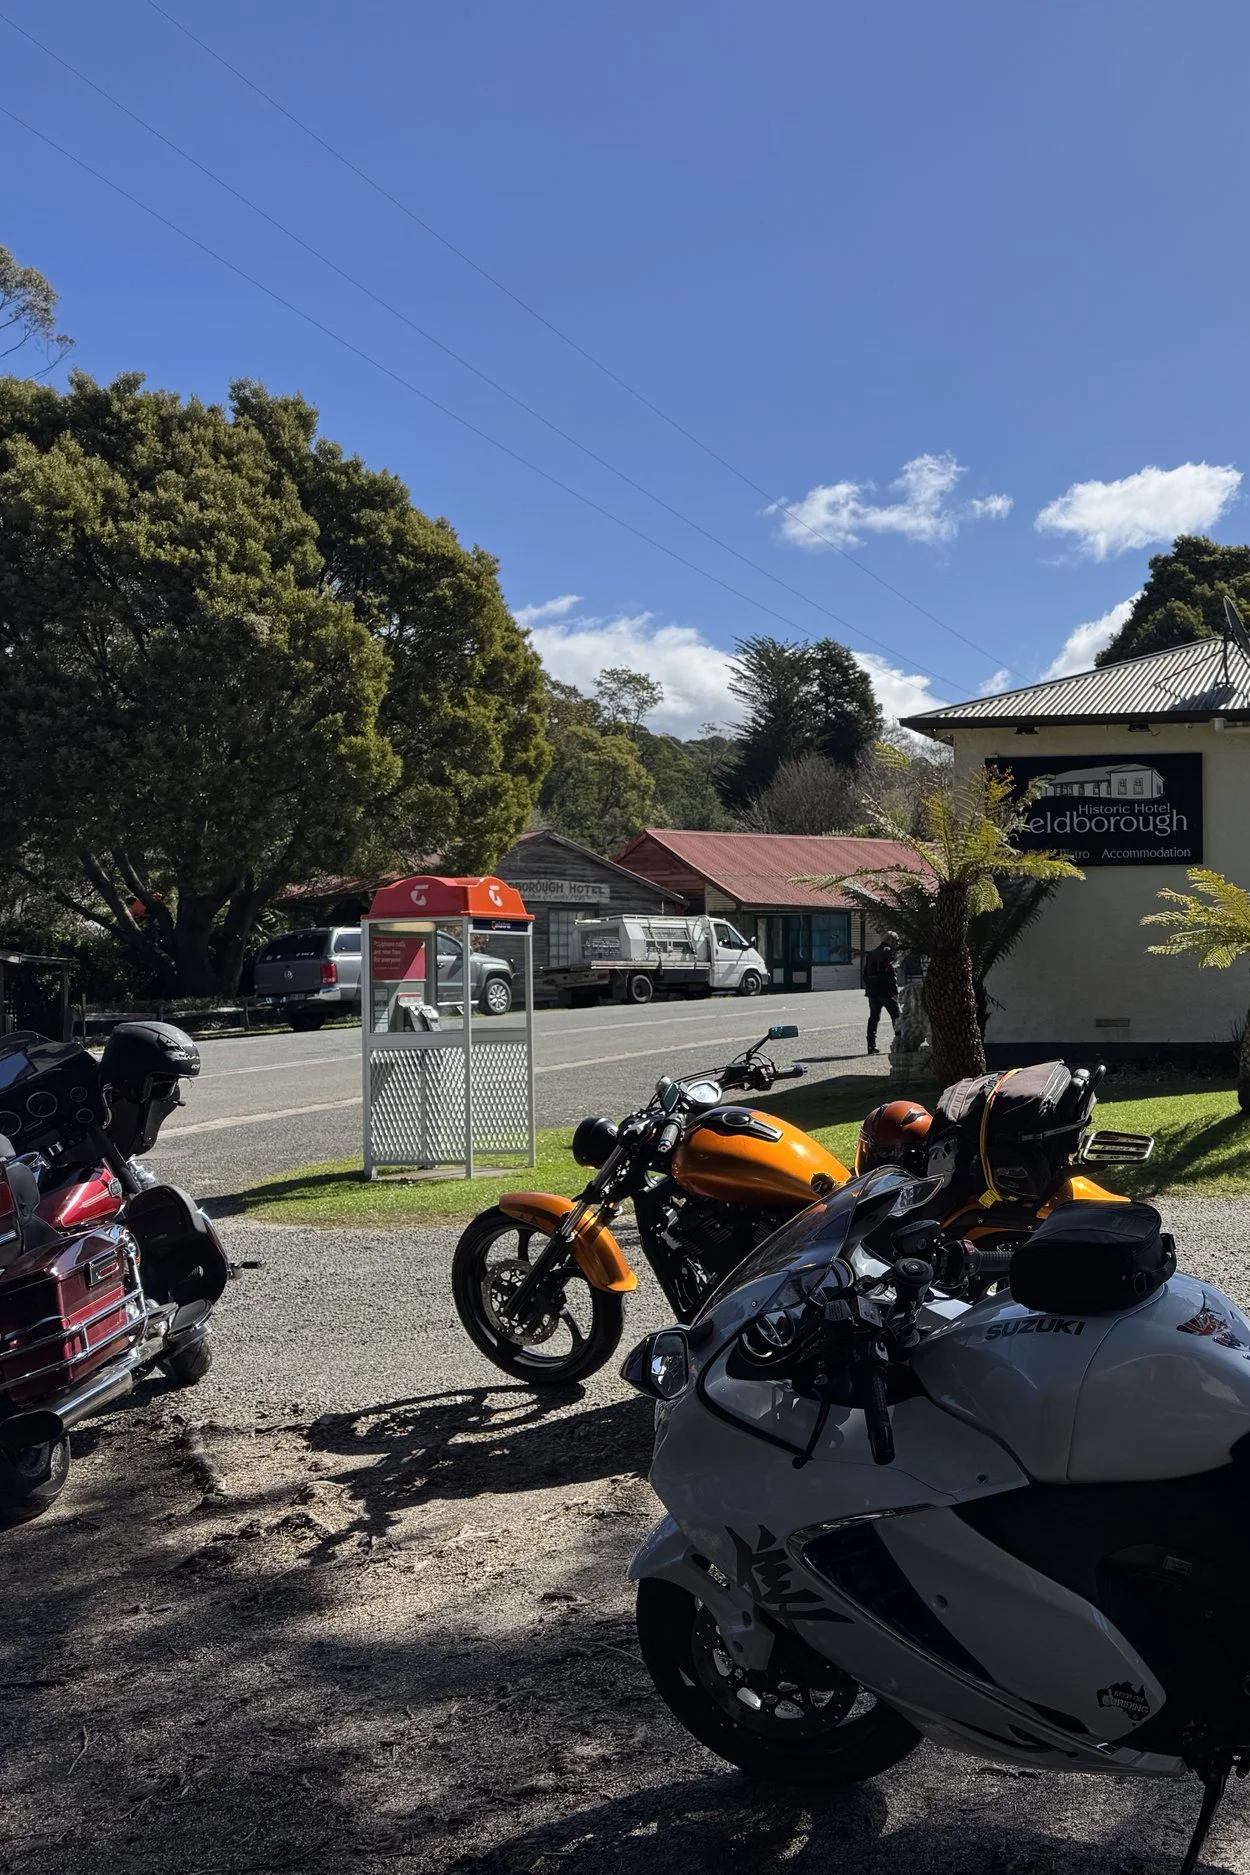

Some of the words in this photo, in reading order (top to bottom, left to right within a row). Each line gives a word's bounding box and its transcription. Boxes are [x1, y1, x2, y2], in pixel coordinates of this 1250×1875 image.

[1078, 803, 1130, 815] Historic
[1134, 802, 1171, 814] Hotel
[1101, 846, 1191, 859] Accommodation
[568, 882, 606, 895] HOTEL
[985, 1318, 1086, 1342] SUZUKI
[1117, 1698, 1149, 1714] RIDING
